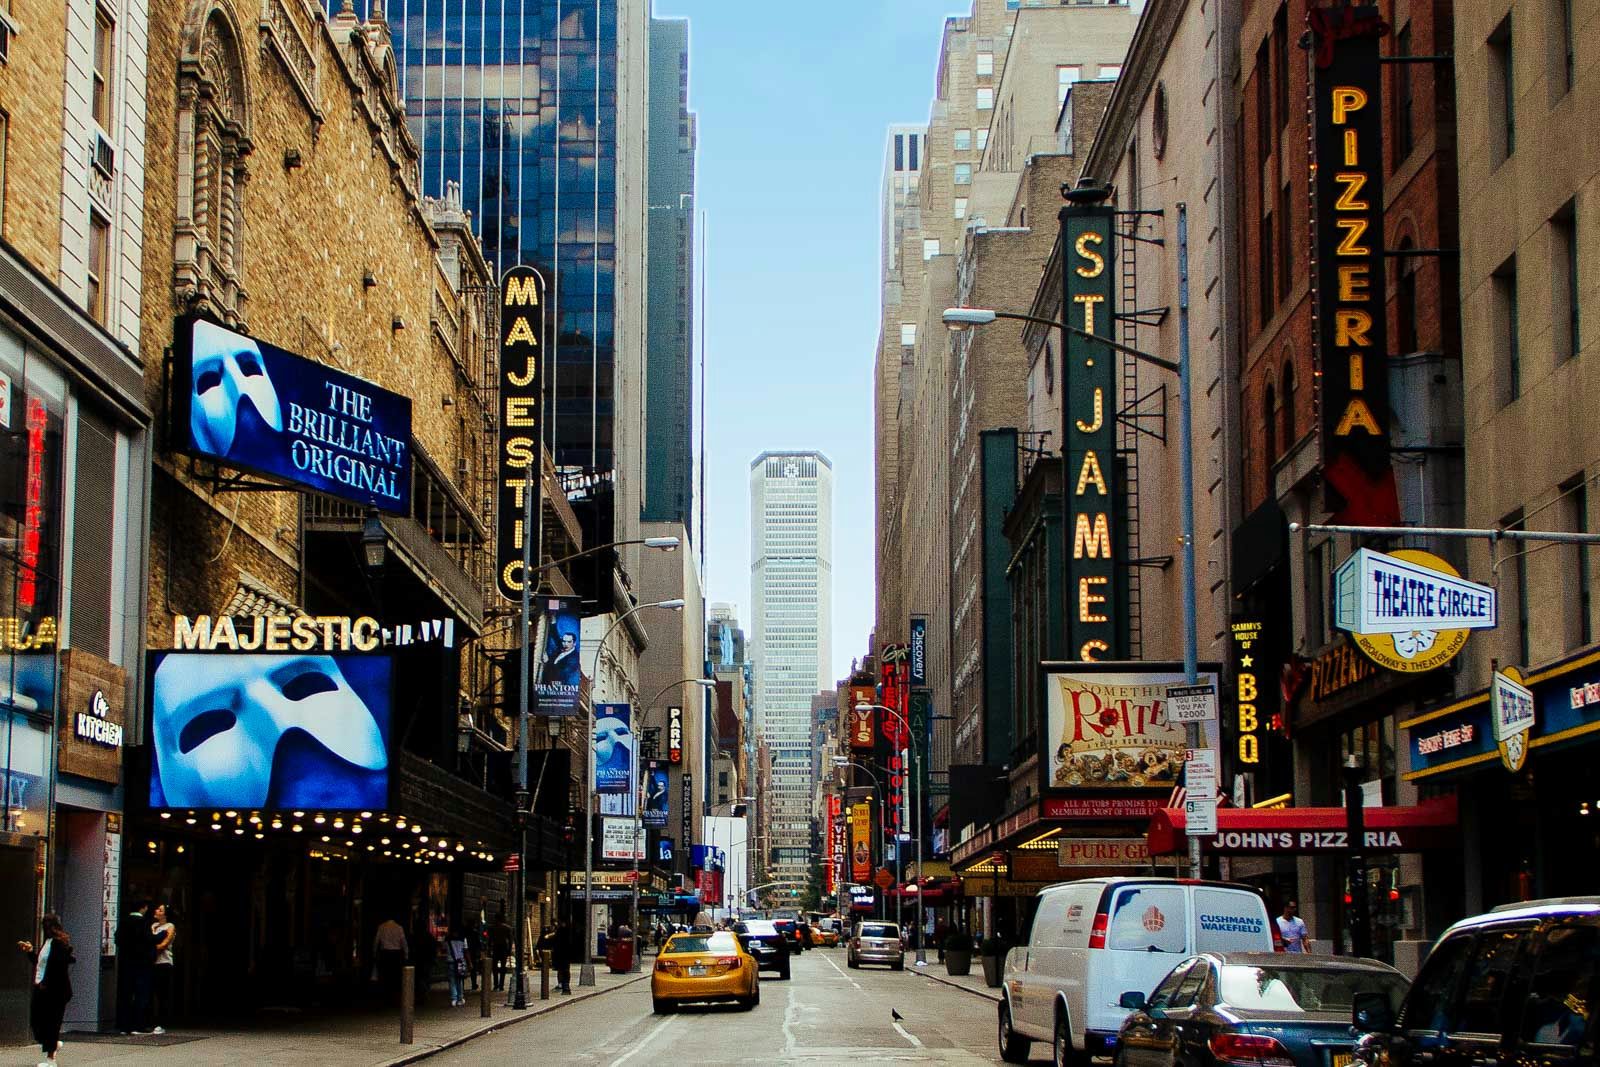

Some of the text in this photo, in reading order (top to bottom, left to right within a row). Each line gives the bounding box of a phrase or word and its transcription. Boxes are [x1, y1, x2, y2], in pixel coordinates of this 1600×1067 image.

[1332, 86, 1383, 436] PIZZERIA
[325, 381, 373, 422] THE
[288, 402, 405, 468] BRILLIANT
[503, 276, 539, 592] MAJESTIC
[292, 439, 401, 500] ORIGINAL
[1374, 569, 1486, 617] THEATRE CIRCLE
[173, 614, 381, 651] MAJESTIC
[1235, 632, 1258, 640] HOUSE
[1242, 640, 1251, 649] OF
[914, 630, 925, 679] Discovery
[1359, 631, 1465, 670] BROADWAY'S THEATRE SHOP
[535, 684, 579, 692] PHANTOM
[1081, 684, 1169, 697] SOMETHI
[1179, 710, 1206, 718] $2000
[1238, 673, 1259, 764] BBQ
[78, 713, 122, 746] KITCHEN
[670, 708, 681, 749] PARK
[1186, 751, 1193, 761] 3
[683, 775, 691, 819] MINSKOFF
[1063, 800, 1079, 808] ALL
[1112, 800, 1145, 808] PROMISE
[1148, 800, 1158, 808] TO
[1187, 802, 1194, 812] 6
[1051, 807, 1090, 816] MEMORIZE
[1093, 807, 1114, 816] MOST
[1116, 807, 1123, 815] OF
[1126, 806, 1147, 815] THEIR
[1070, 844, 1120, 859] PURE
[1212, 832, 1402, 848] JOHN'S PIZZRIA
[1200, 914, 1255, 925] CUSHMAN
[1201, 922, 1261, 933] WAKEFIELD
